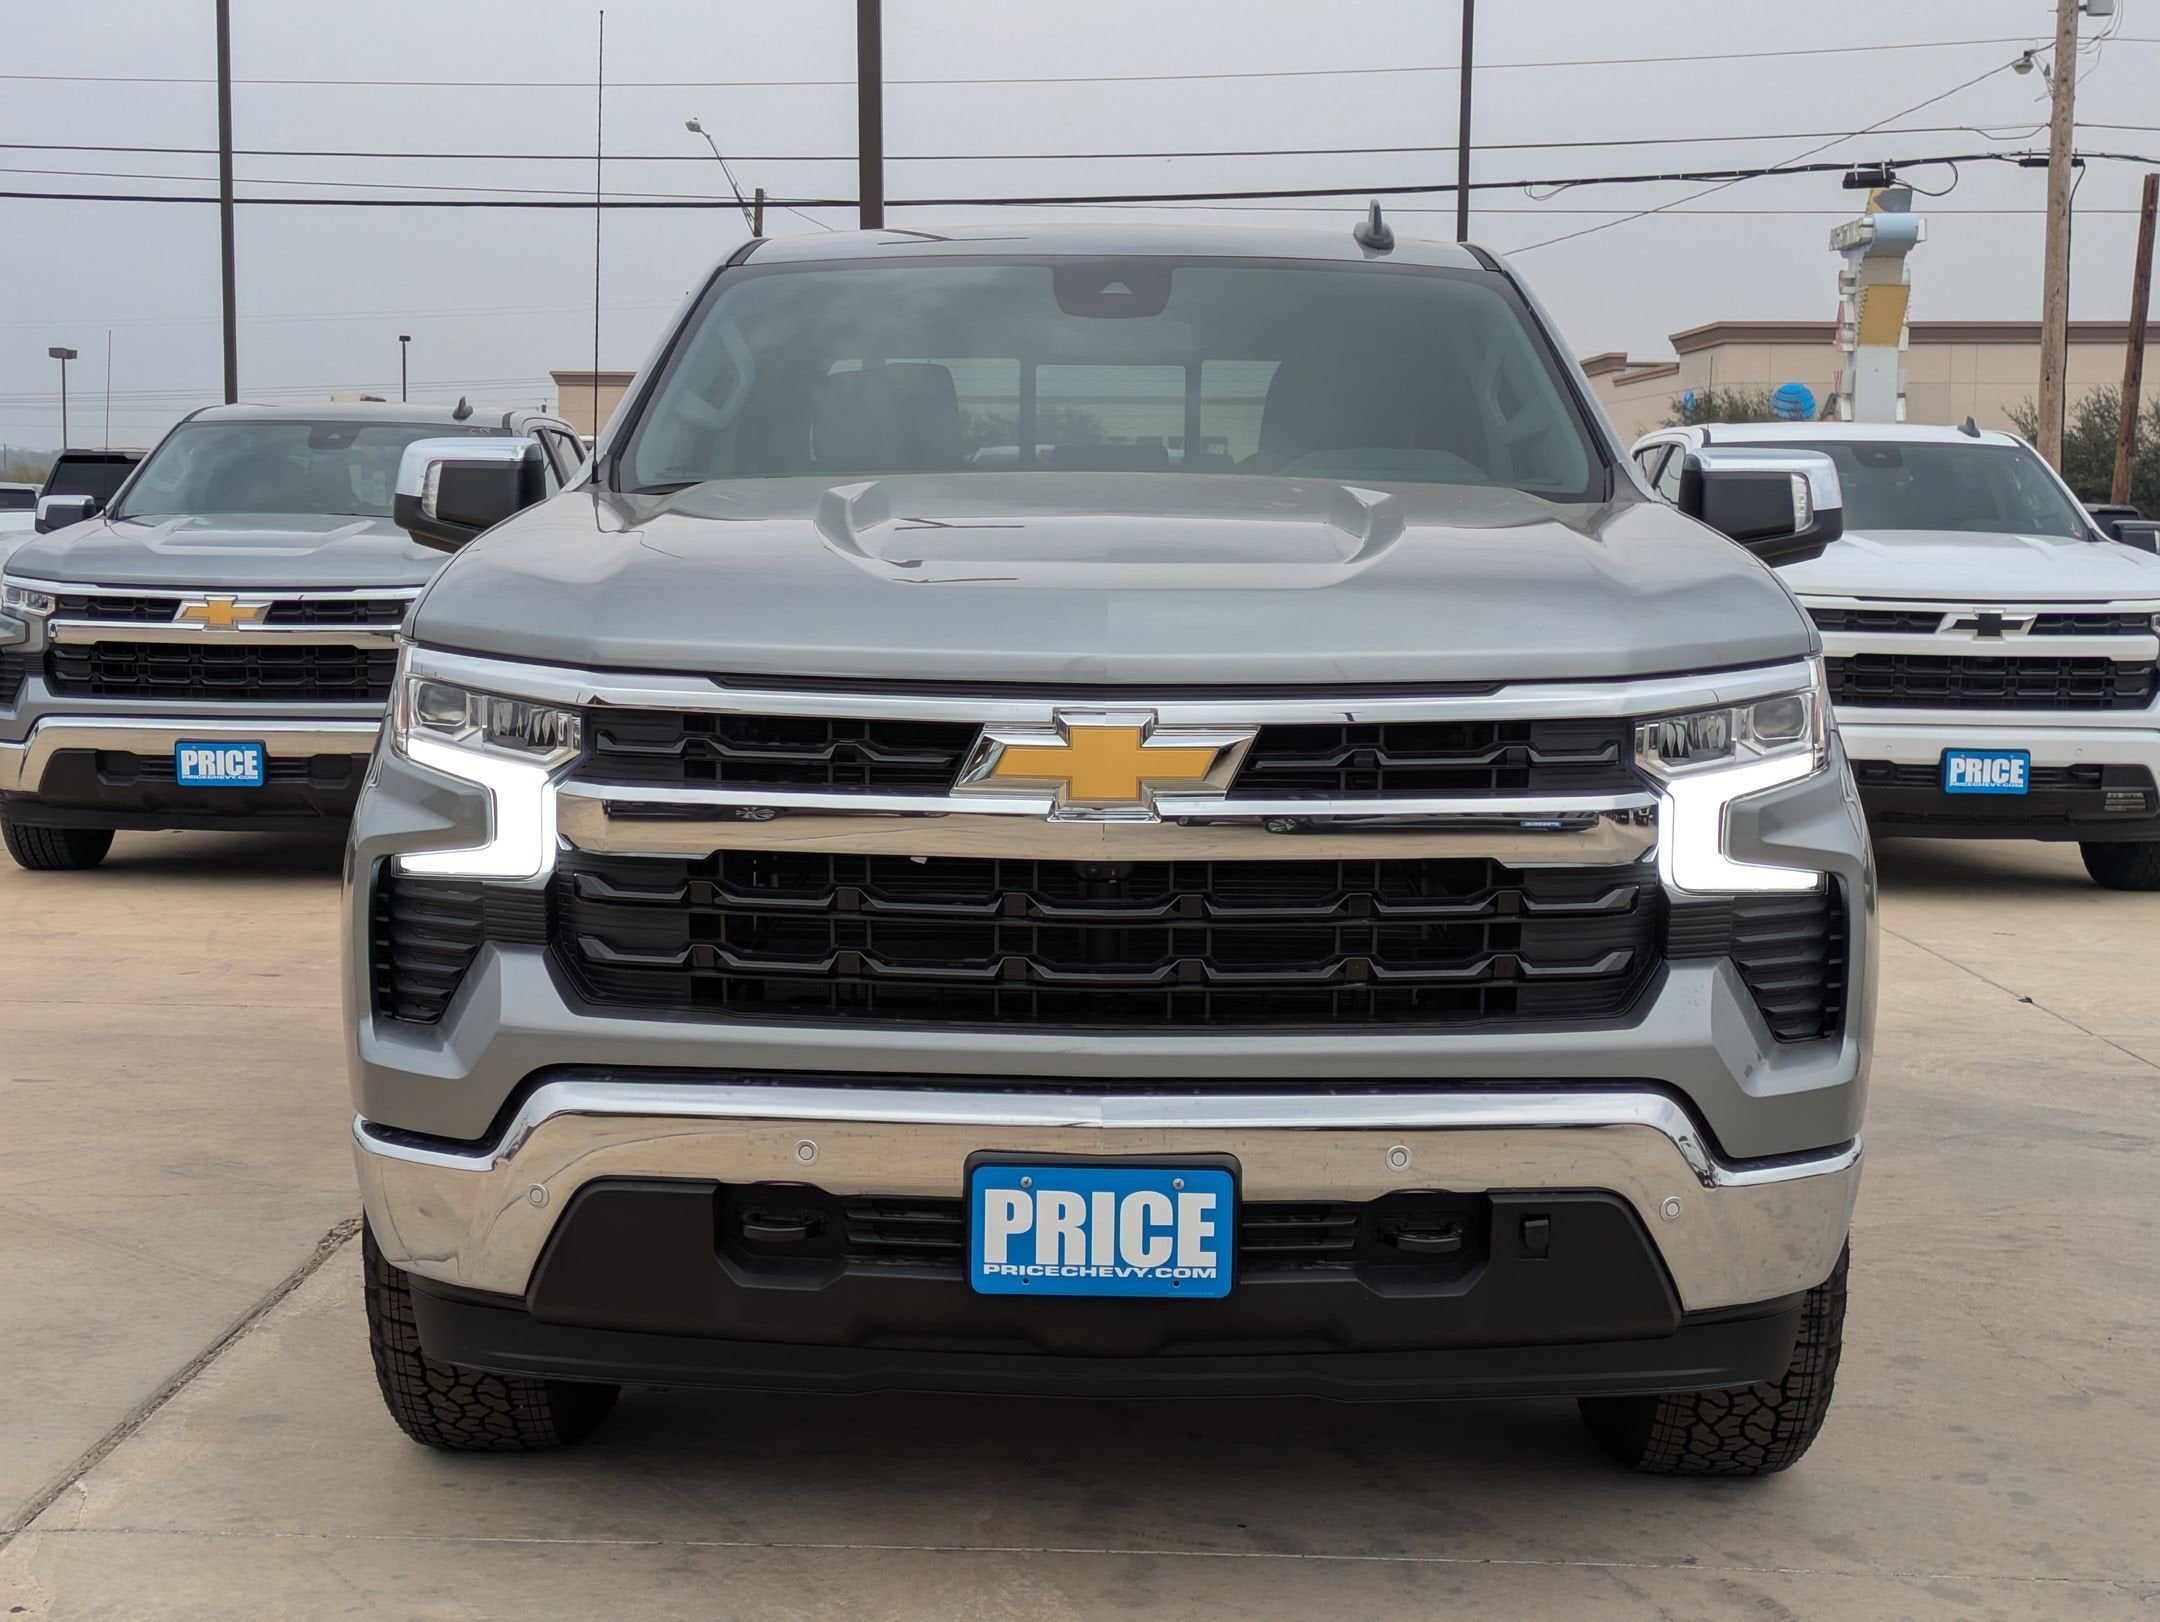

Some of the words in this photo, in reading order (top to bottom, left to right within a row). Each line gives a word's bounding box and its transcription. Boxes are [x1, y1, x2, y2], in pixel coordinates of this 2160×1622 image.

[180, 750, 258, 775] PRICE
[1950, 758, 2024, 785] PRICE
[983, 1189, 1217, 1268] PRICE
[983, 1264, 1218, 1279] PRICECHEVY.COM
